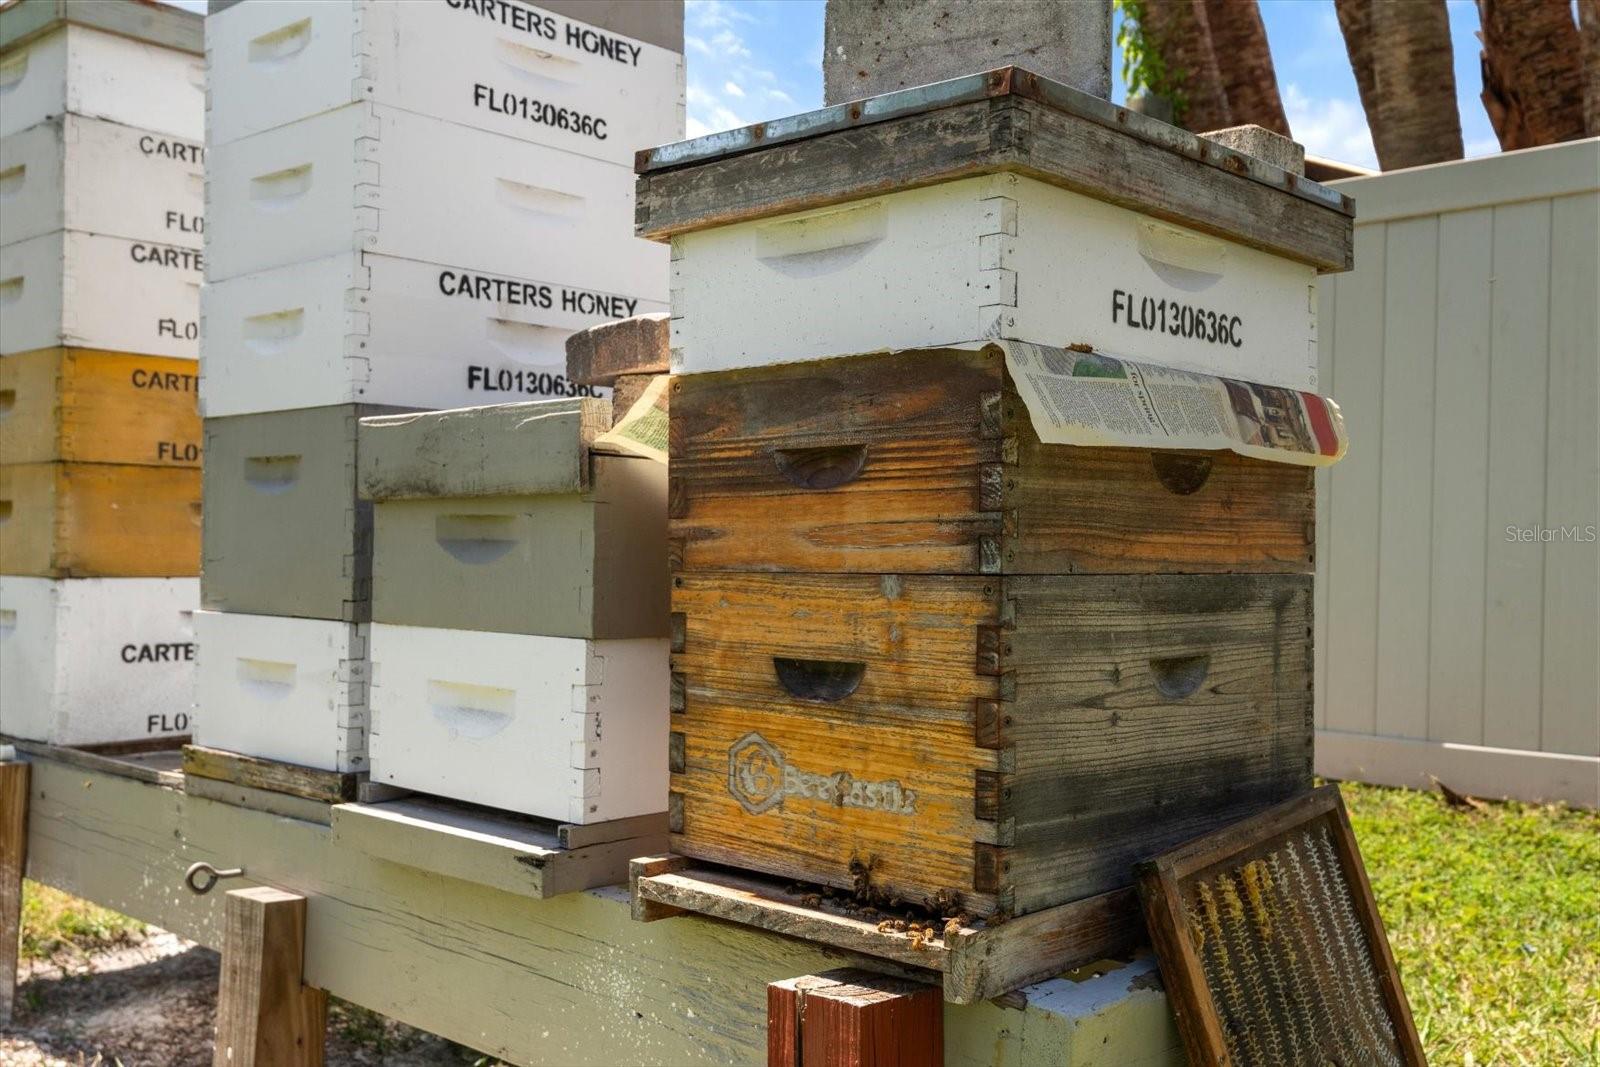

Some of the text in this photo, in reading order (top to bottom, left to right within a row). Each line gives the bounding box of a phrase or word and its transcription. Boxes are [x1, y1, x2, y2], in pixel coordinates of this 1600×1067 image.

[565, 23, 642, 67] HONEY
[474, 83, 608, 140] FL0130636C
[438, 271, 638, 318] CARTERS HONEY
[1112, 289, 1243, 348] FL0130636C
[121, 643, 194, 663] CARTE
